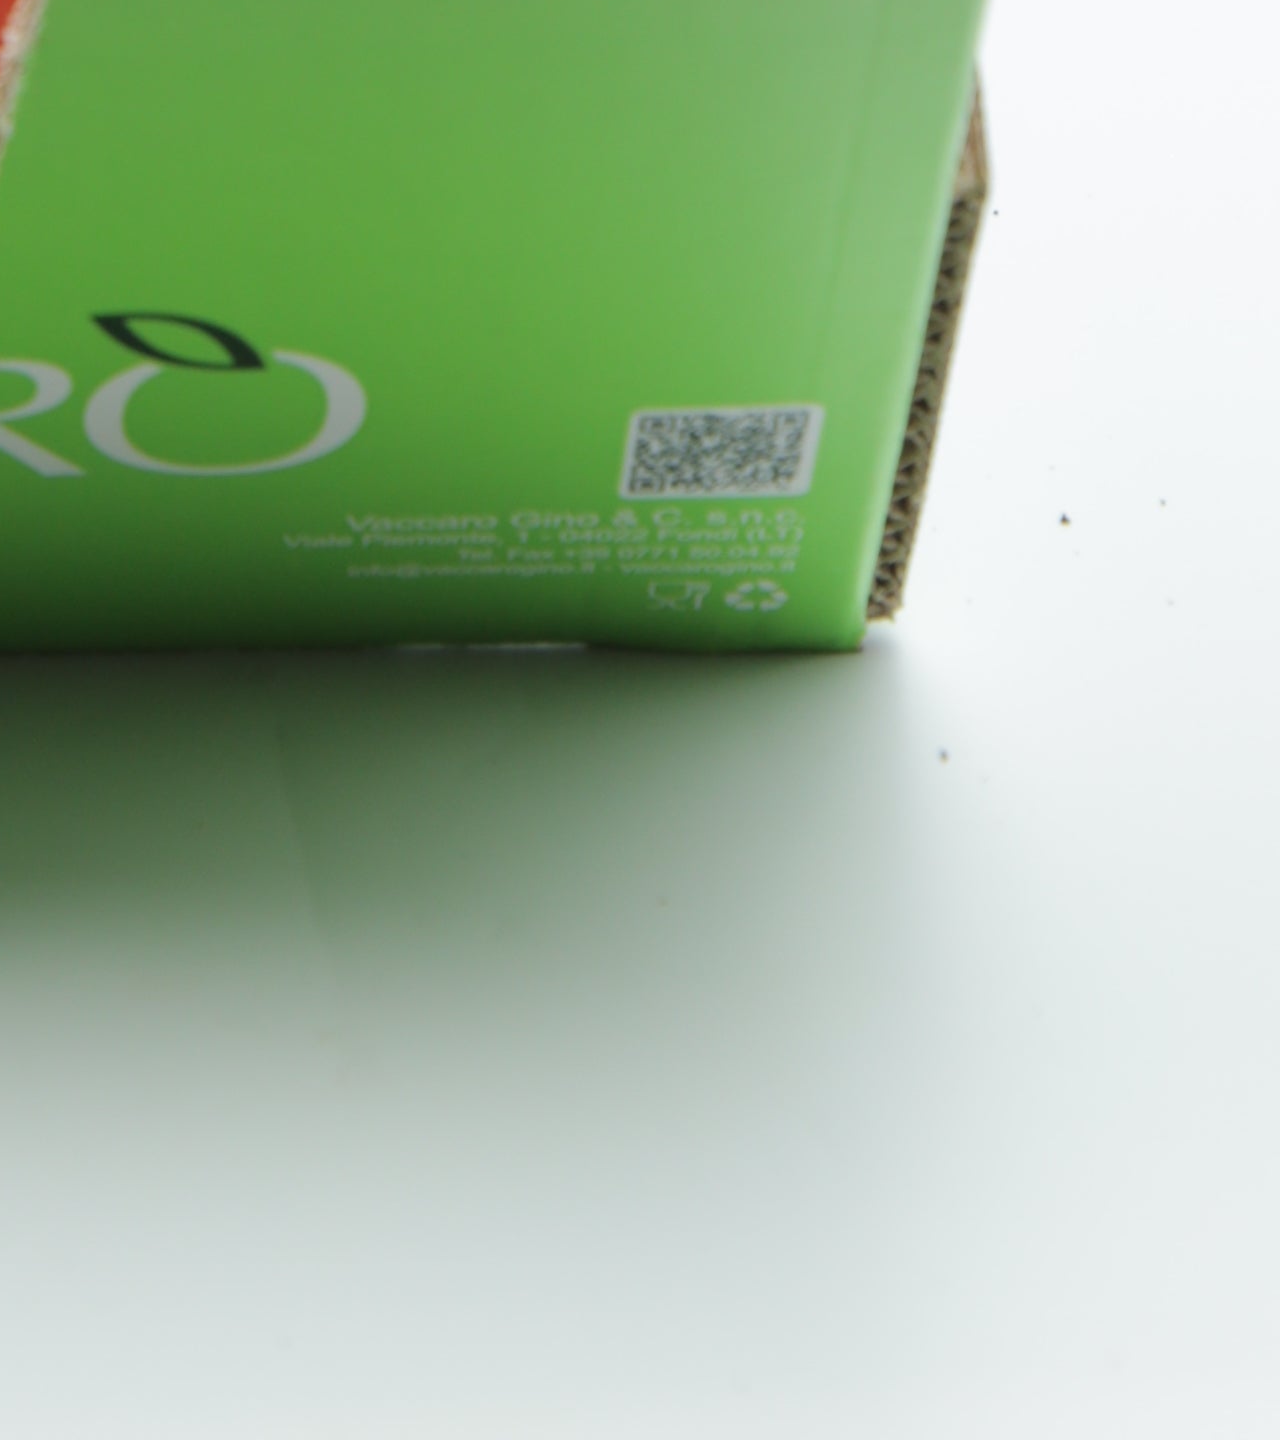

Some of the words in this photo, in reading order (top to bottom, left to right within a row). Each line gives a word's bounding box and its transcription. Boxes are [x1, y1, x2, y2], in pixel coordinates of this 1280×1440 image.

[345, 512, 499, 533] Vaccaro
[510, 509, 600, 529] Gino
[611, 507, 639, 528] &
[282, 532, 353, 549] Viale
[656, 527, 739, 543] Fondi
